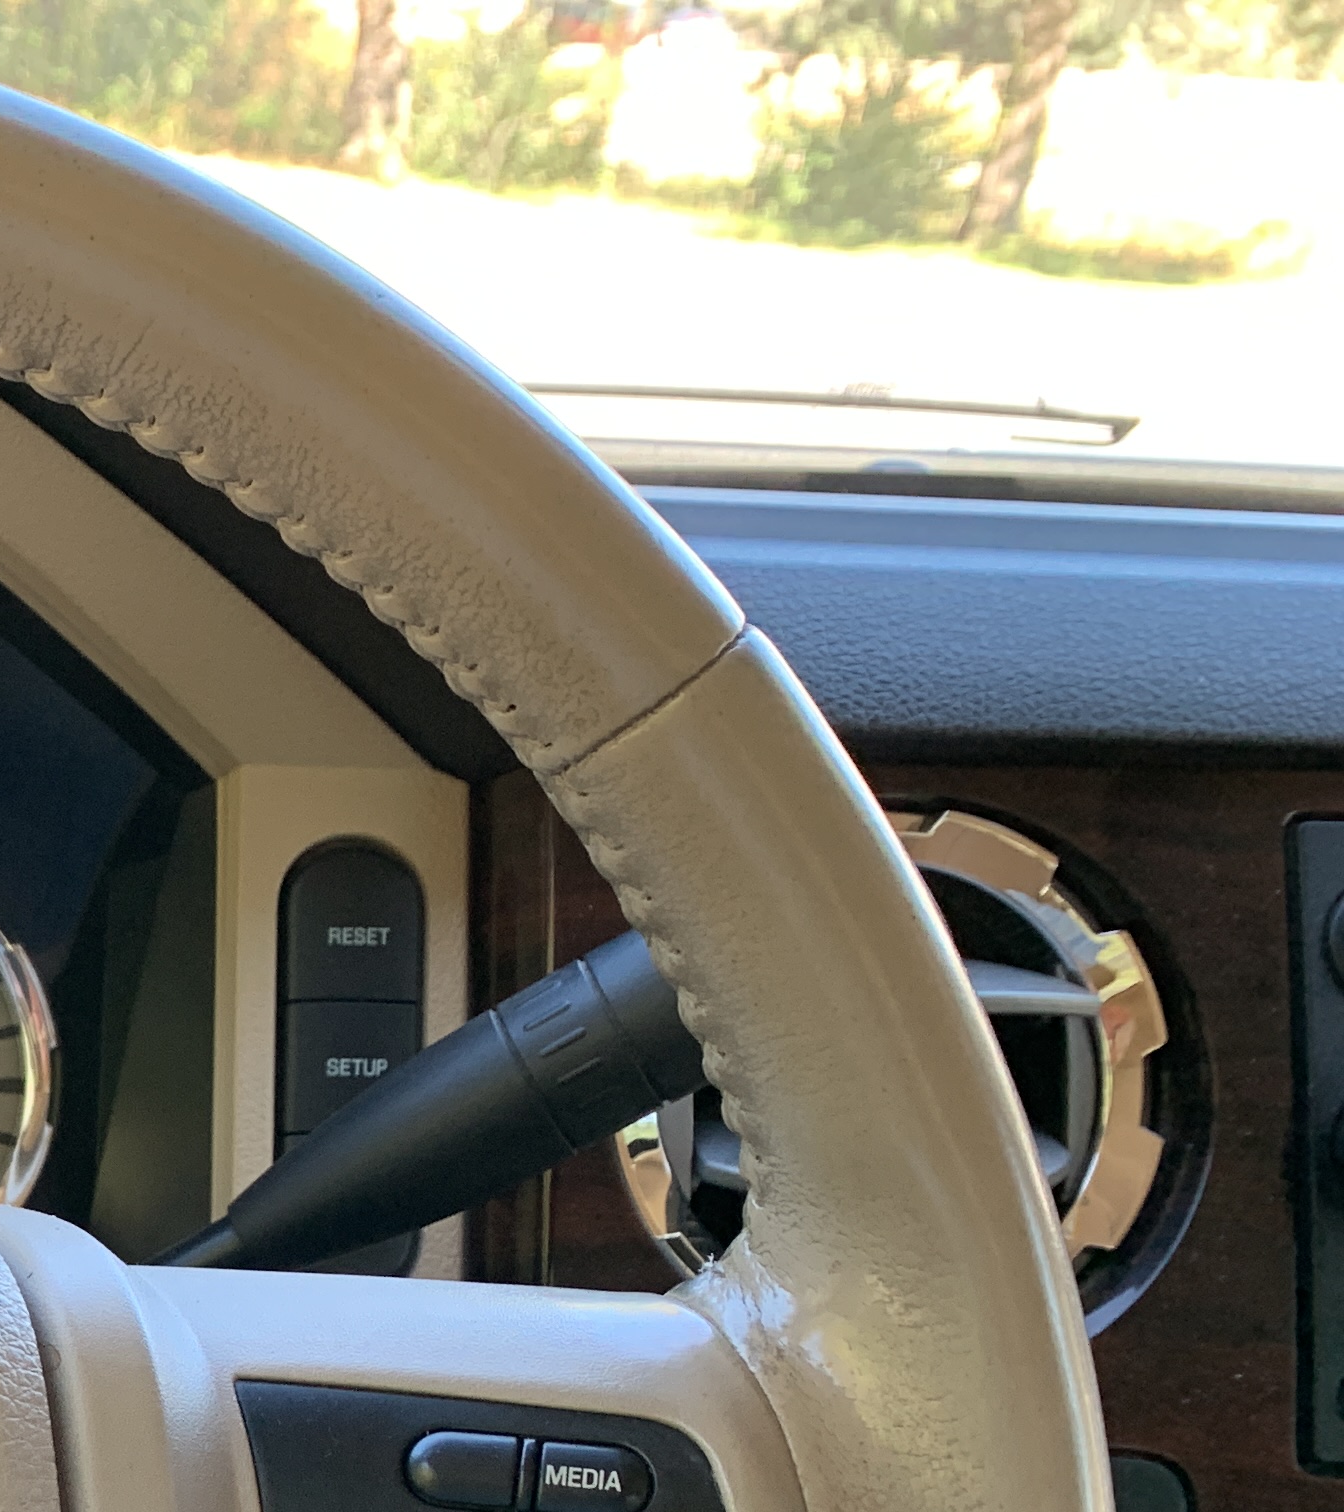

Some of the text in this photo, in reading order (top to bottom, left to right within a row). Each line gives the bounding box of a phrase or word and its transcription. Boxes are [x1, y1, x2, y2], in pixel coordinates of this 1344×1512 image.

[327, 926, 391, 947] RESET
[325, 1057, 389, 1078] SETUP
[545, 1464, 622, 1493] MEDIA
